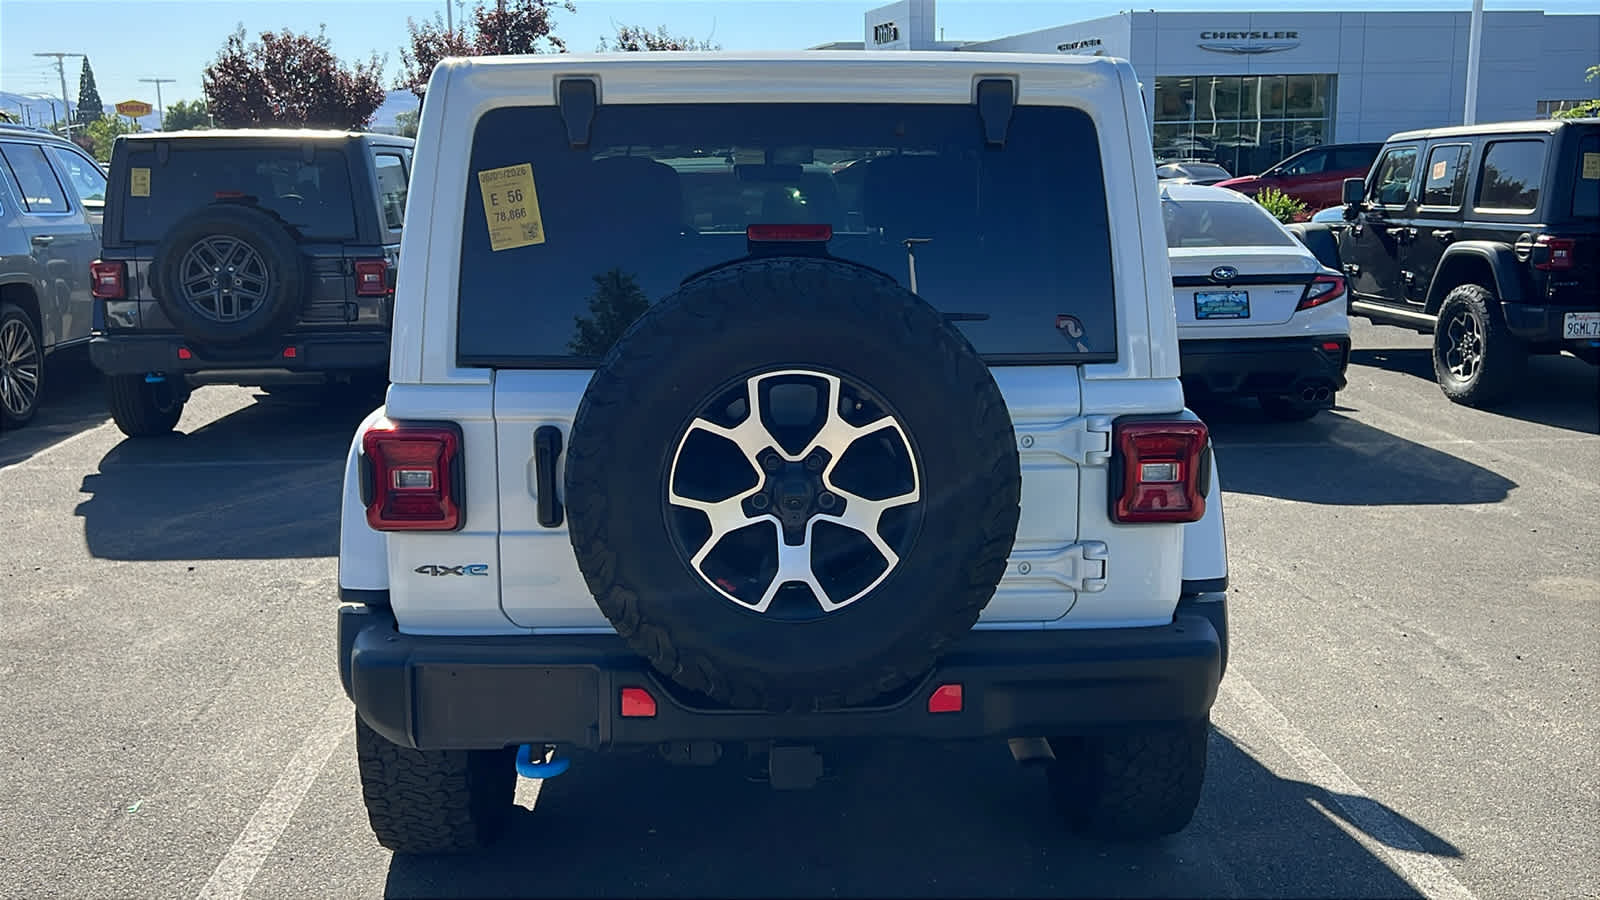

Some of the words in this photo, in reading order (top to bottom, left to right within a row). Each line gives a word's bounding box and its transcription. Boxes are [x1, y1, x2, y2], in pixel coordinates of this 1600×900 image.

[1200, 31, 1299, 40] CHRYSLER
[490, 193, 499, 207] E
[507, 189, 523, 204] 56
[494, 208, 527, 222] 78,866
